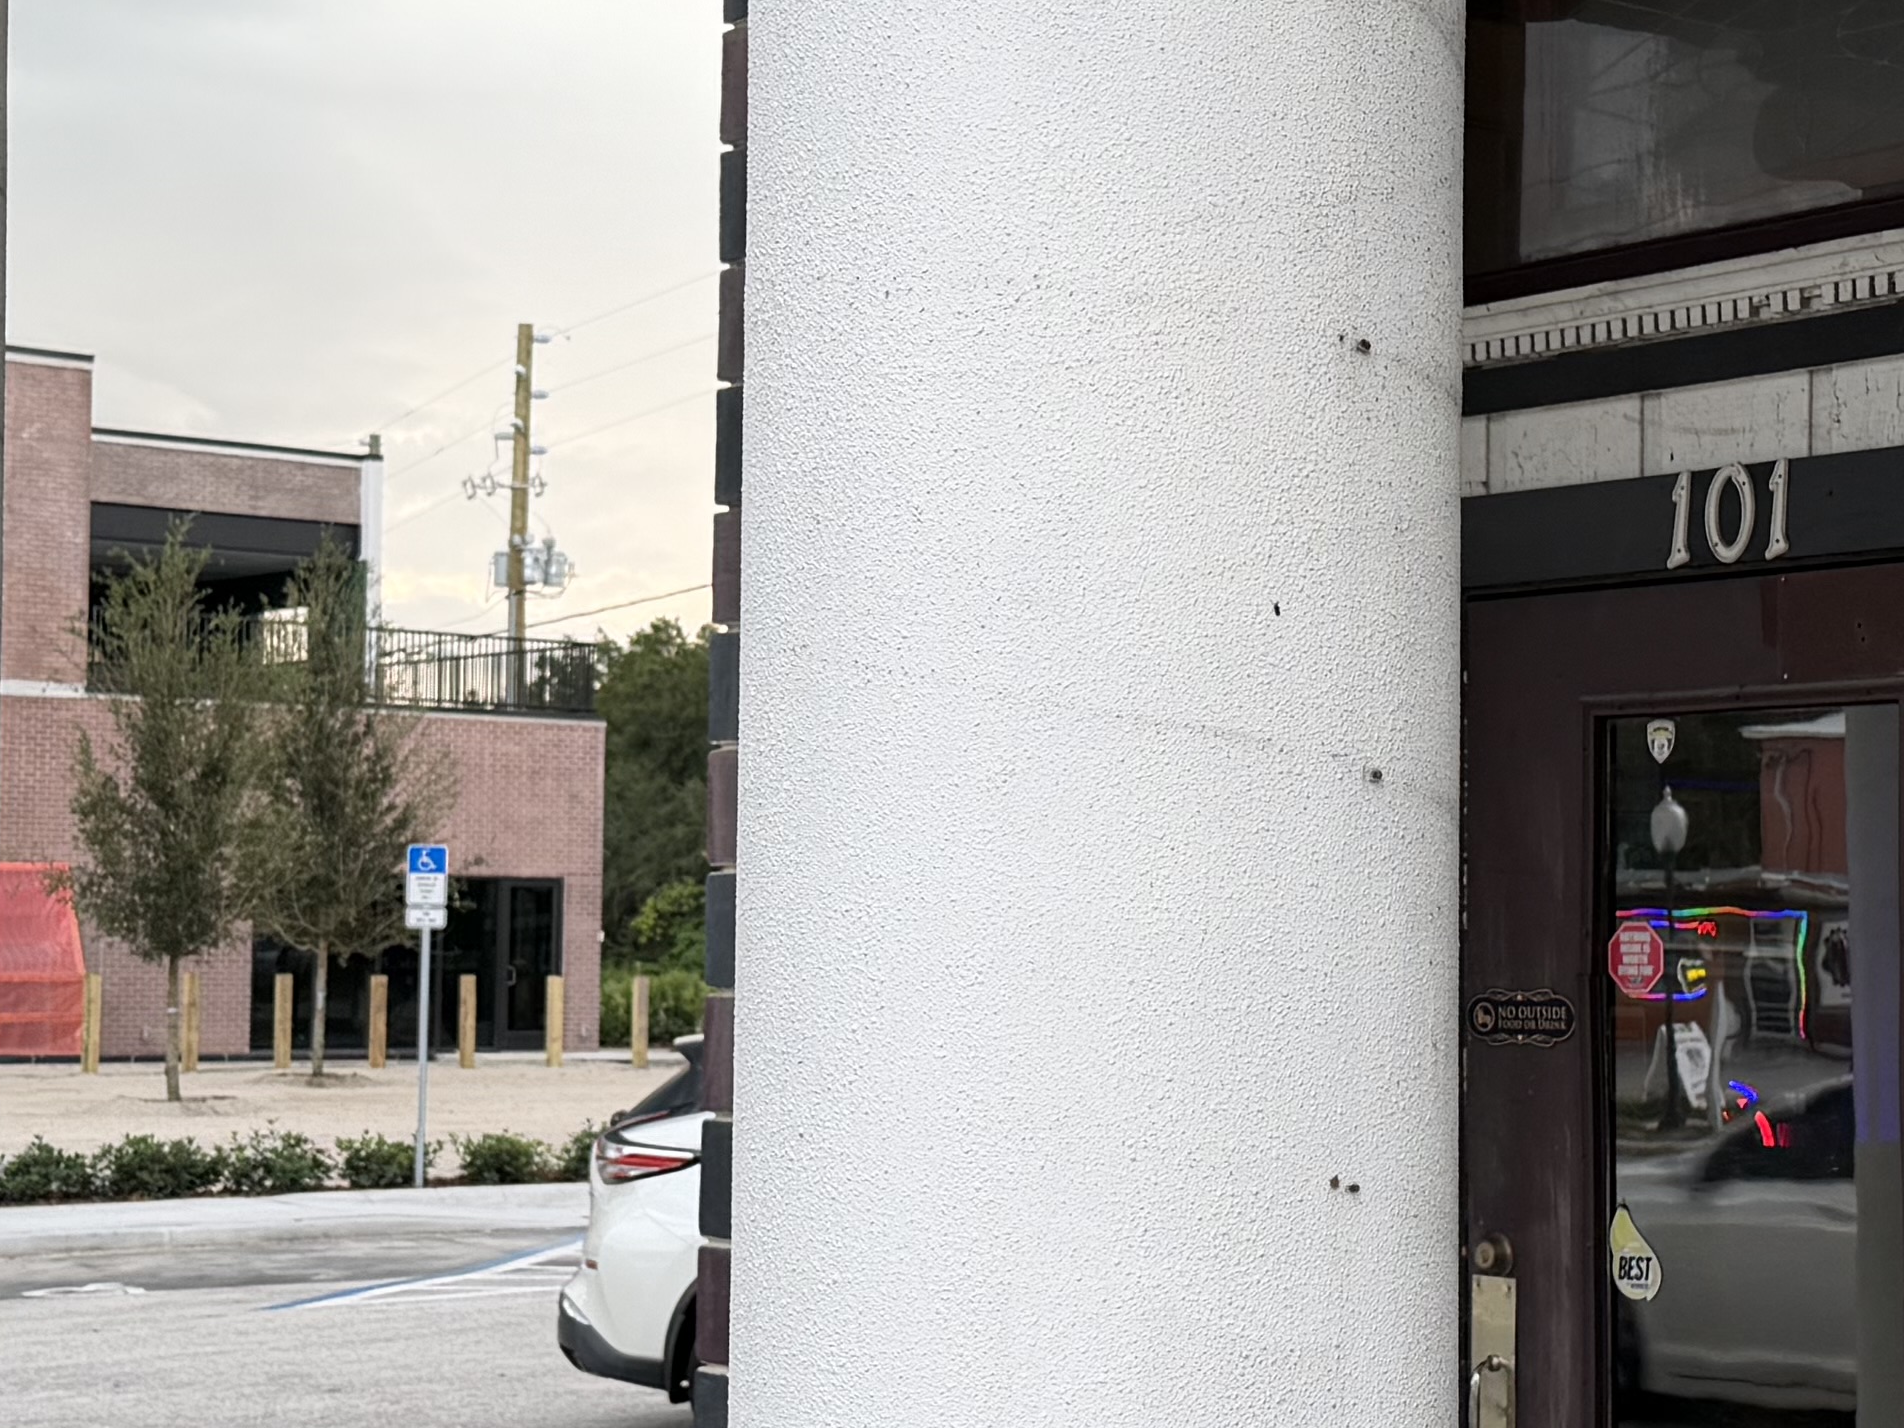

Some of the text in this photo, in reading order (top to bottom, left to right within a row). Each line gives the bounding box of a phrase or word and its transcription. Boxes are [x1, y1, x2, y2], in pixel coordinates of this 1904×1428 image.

[1667, 457, 1791, 570] 101
[1498, 1005, 1567, 1020] NO OUTSIDE
[1618, 1255, 1653, 1281] BEST
